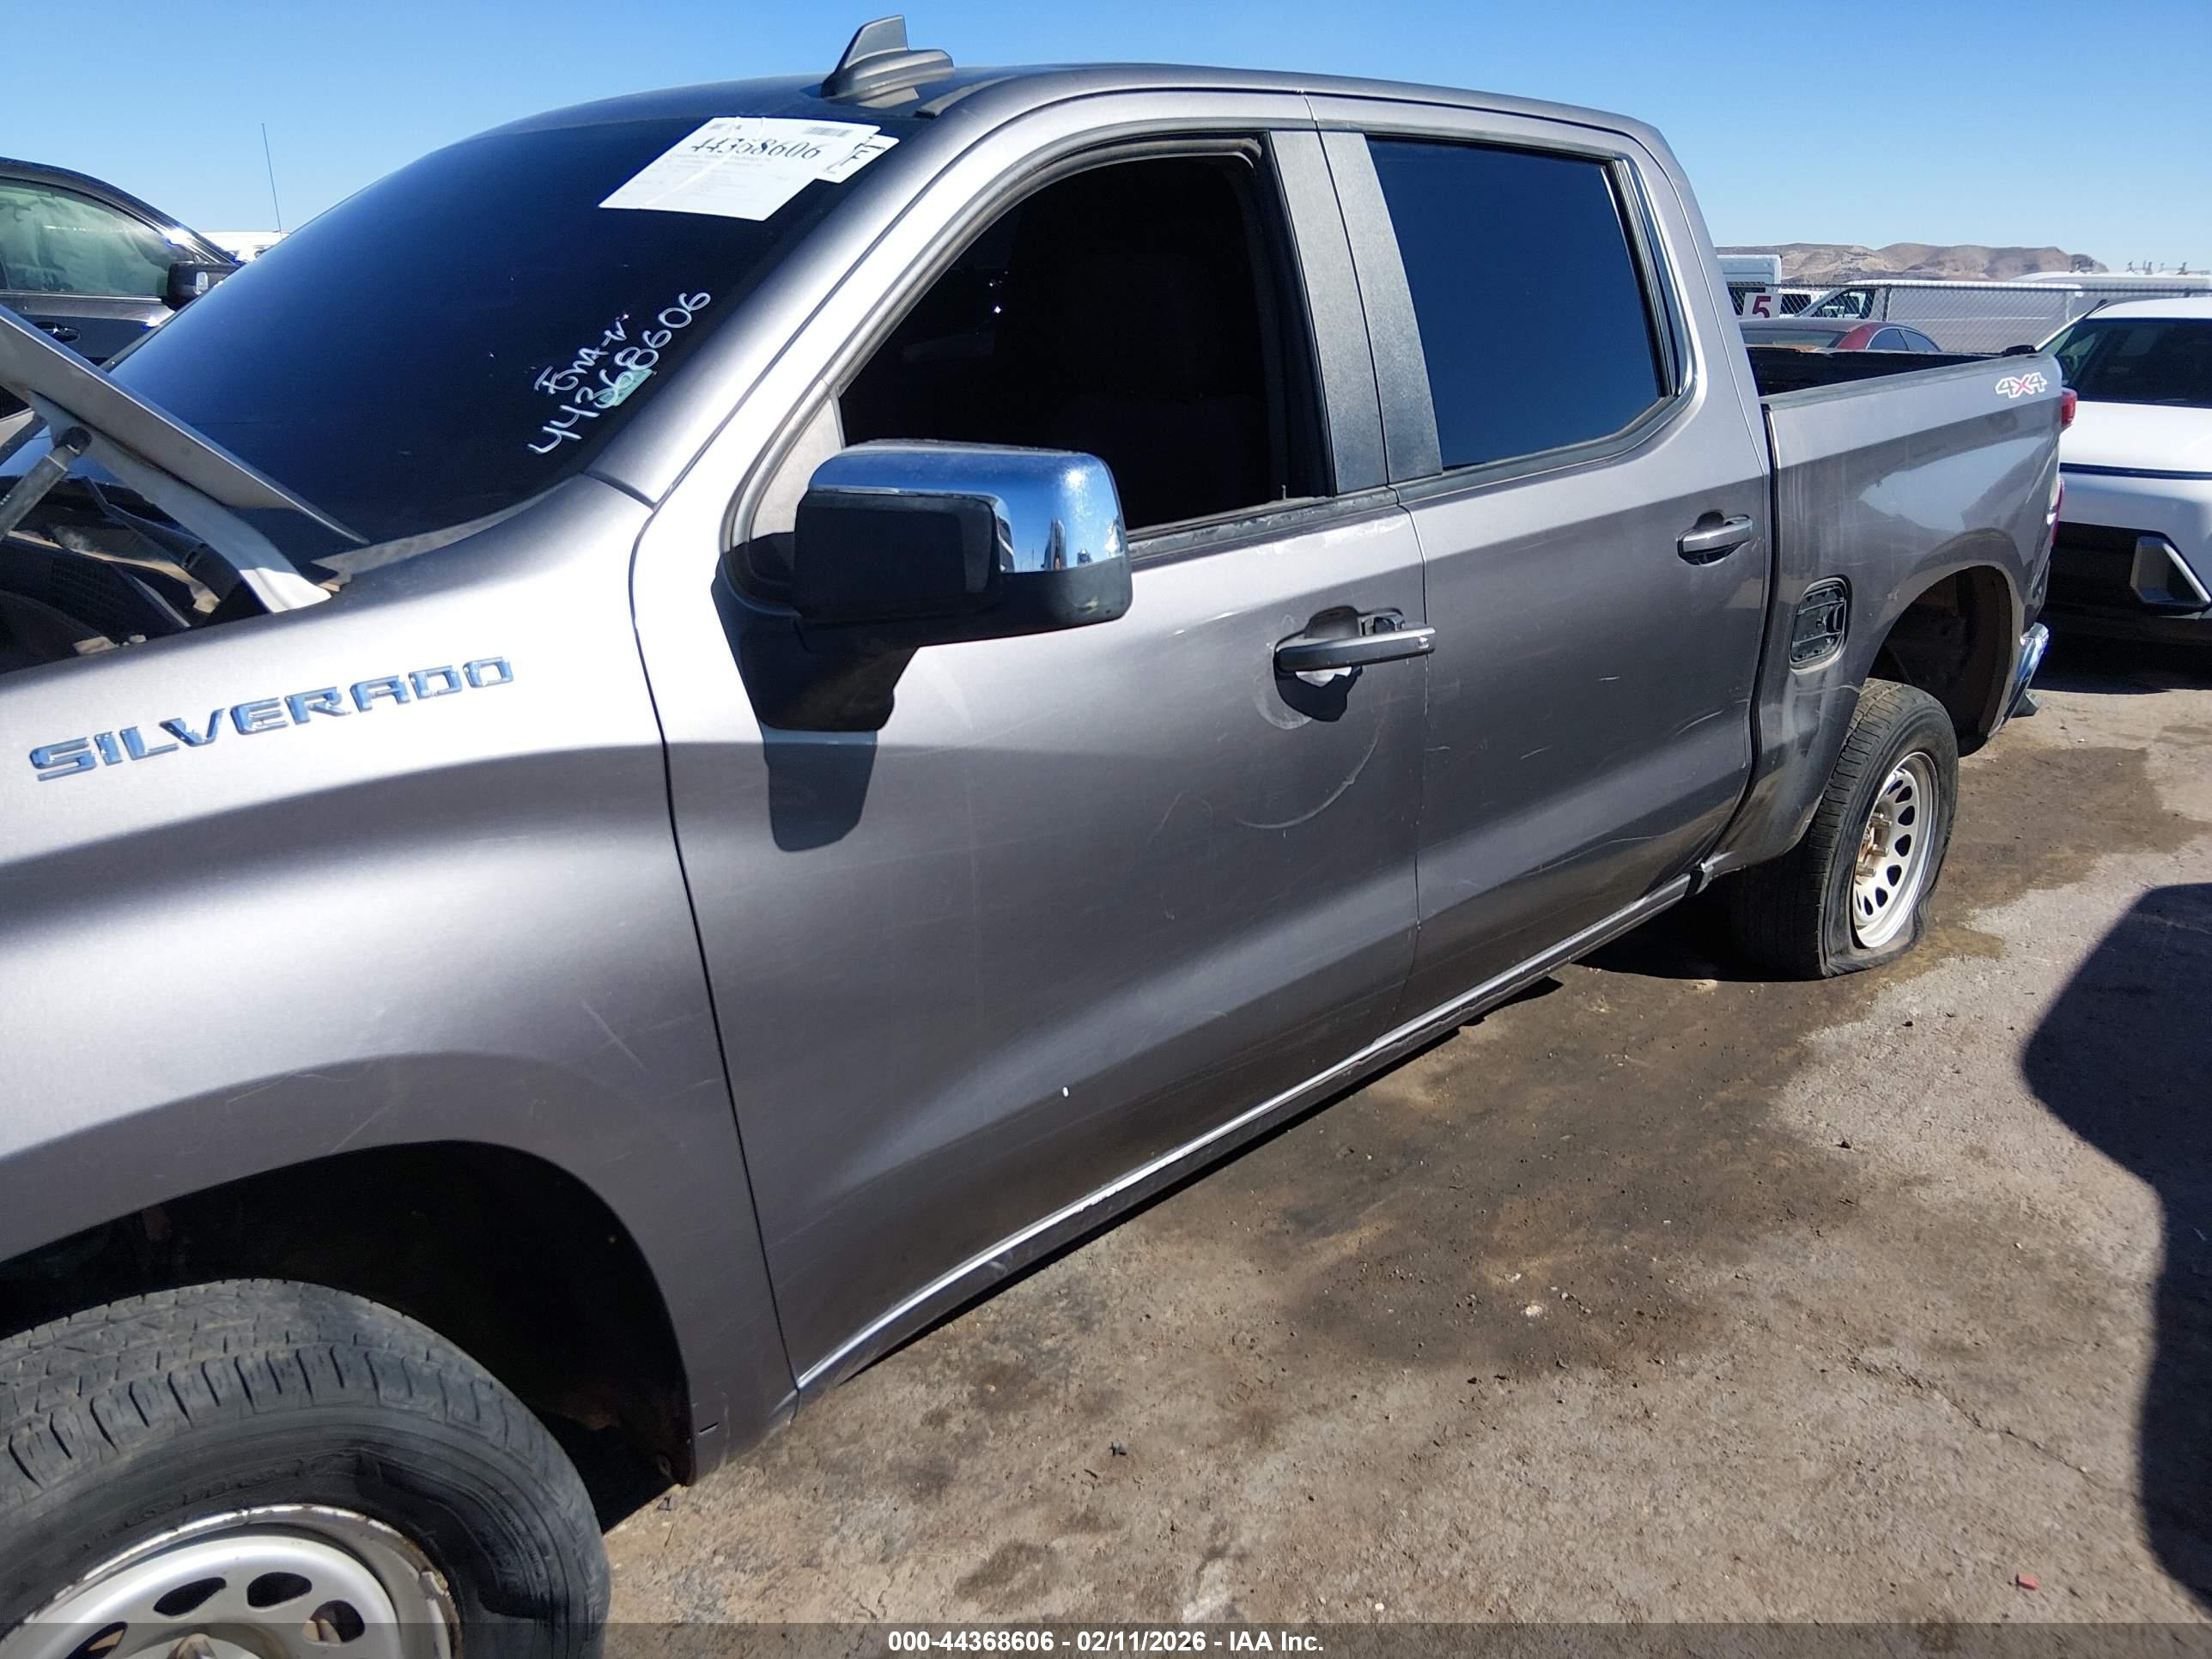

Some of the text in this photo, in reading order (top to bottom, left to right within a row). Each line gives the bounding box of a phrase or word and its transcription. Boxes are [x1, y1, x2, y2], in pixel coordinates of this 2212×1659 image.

[1752, 295, 1771, 319] 5
[526, 291, 712, 455] 44368606
[29, 655, 515, 782] SILVERADO
